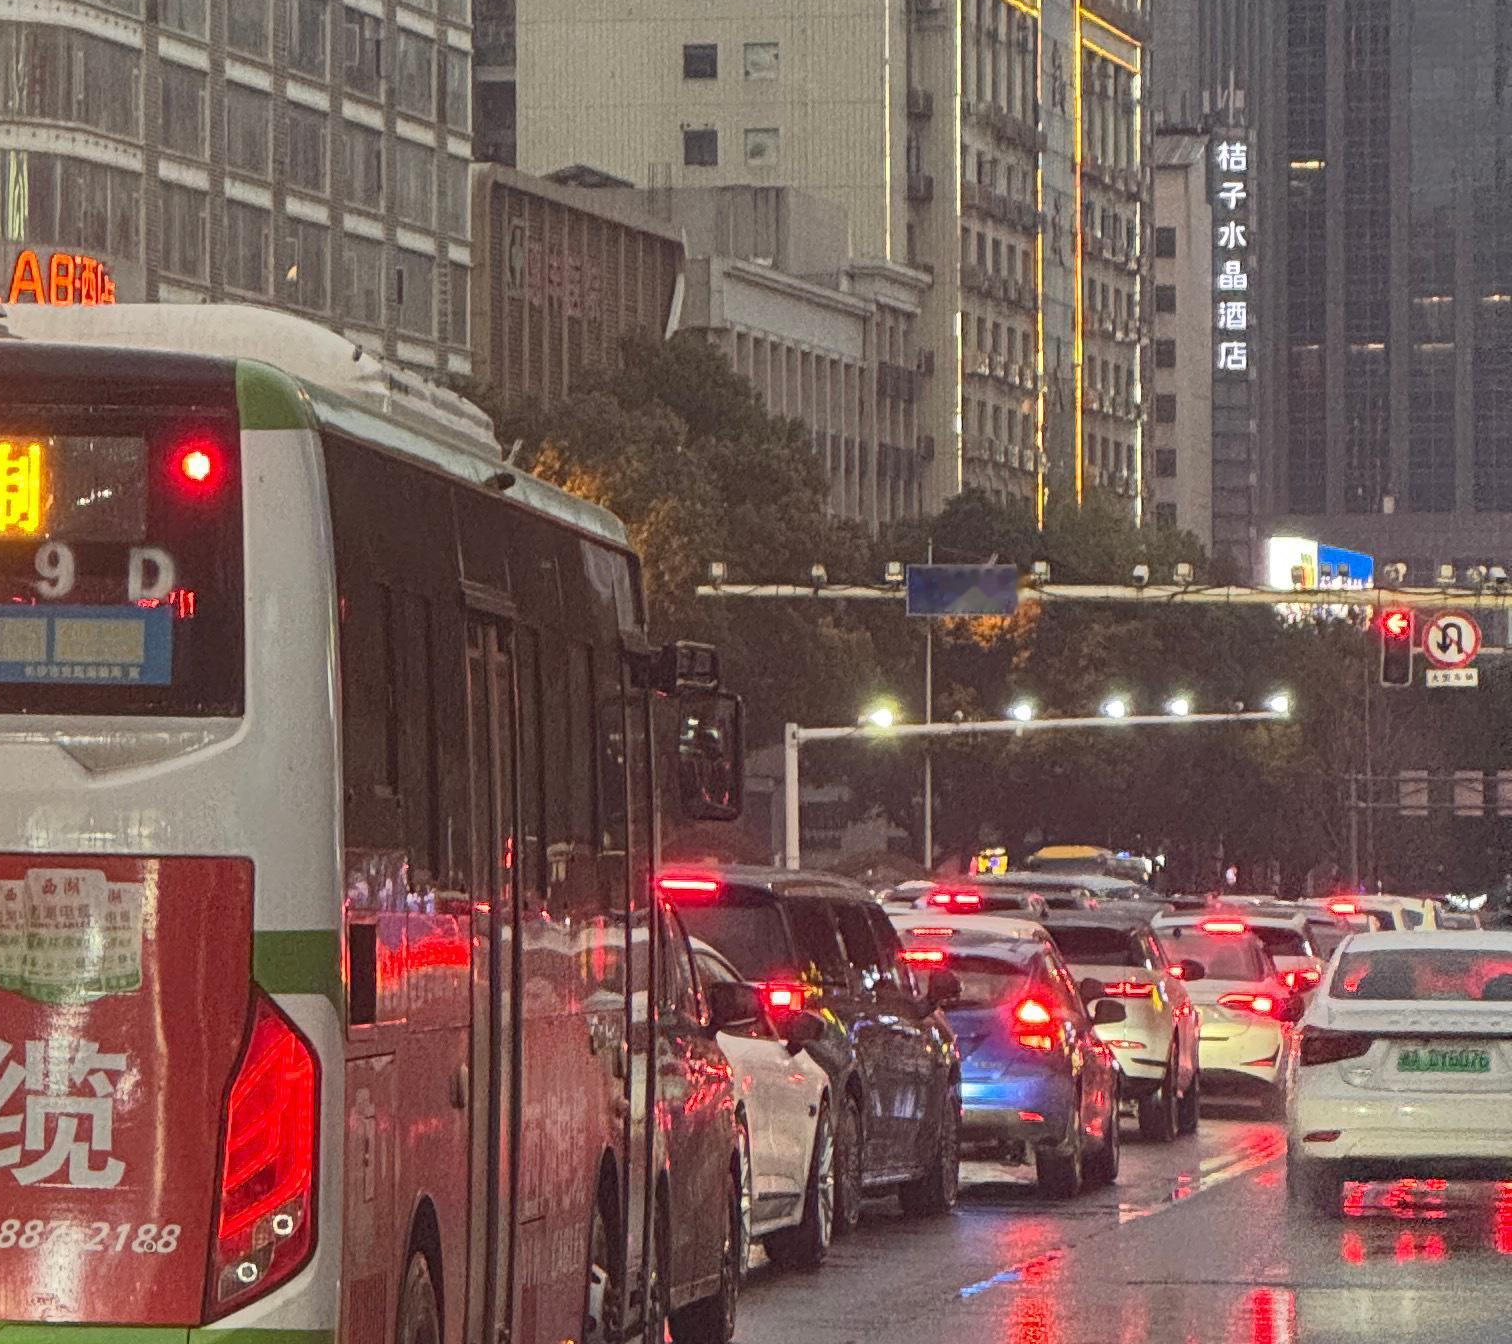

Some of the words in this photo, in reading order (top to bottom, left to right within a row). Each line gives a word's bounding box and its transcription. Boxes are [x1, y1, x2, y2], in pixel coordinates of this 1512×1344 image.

[1217, 141, 1248, 371] 桔子水晶酒店
